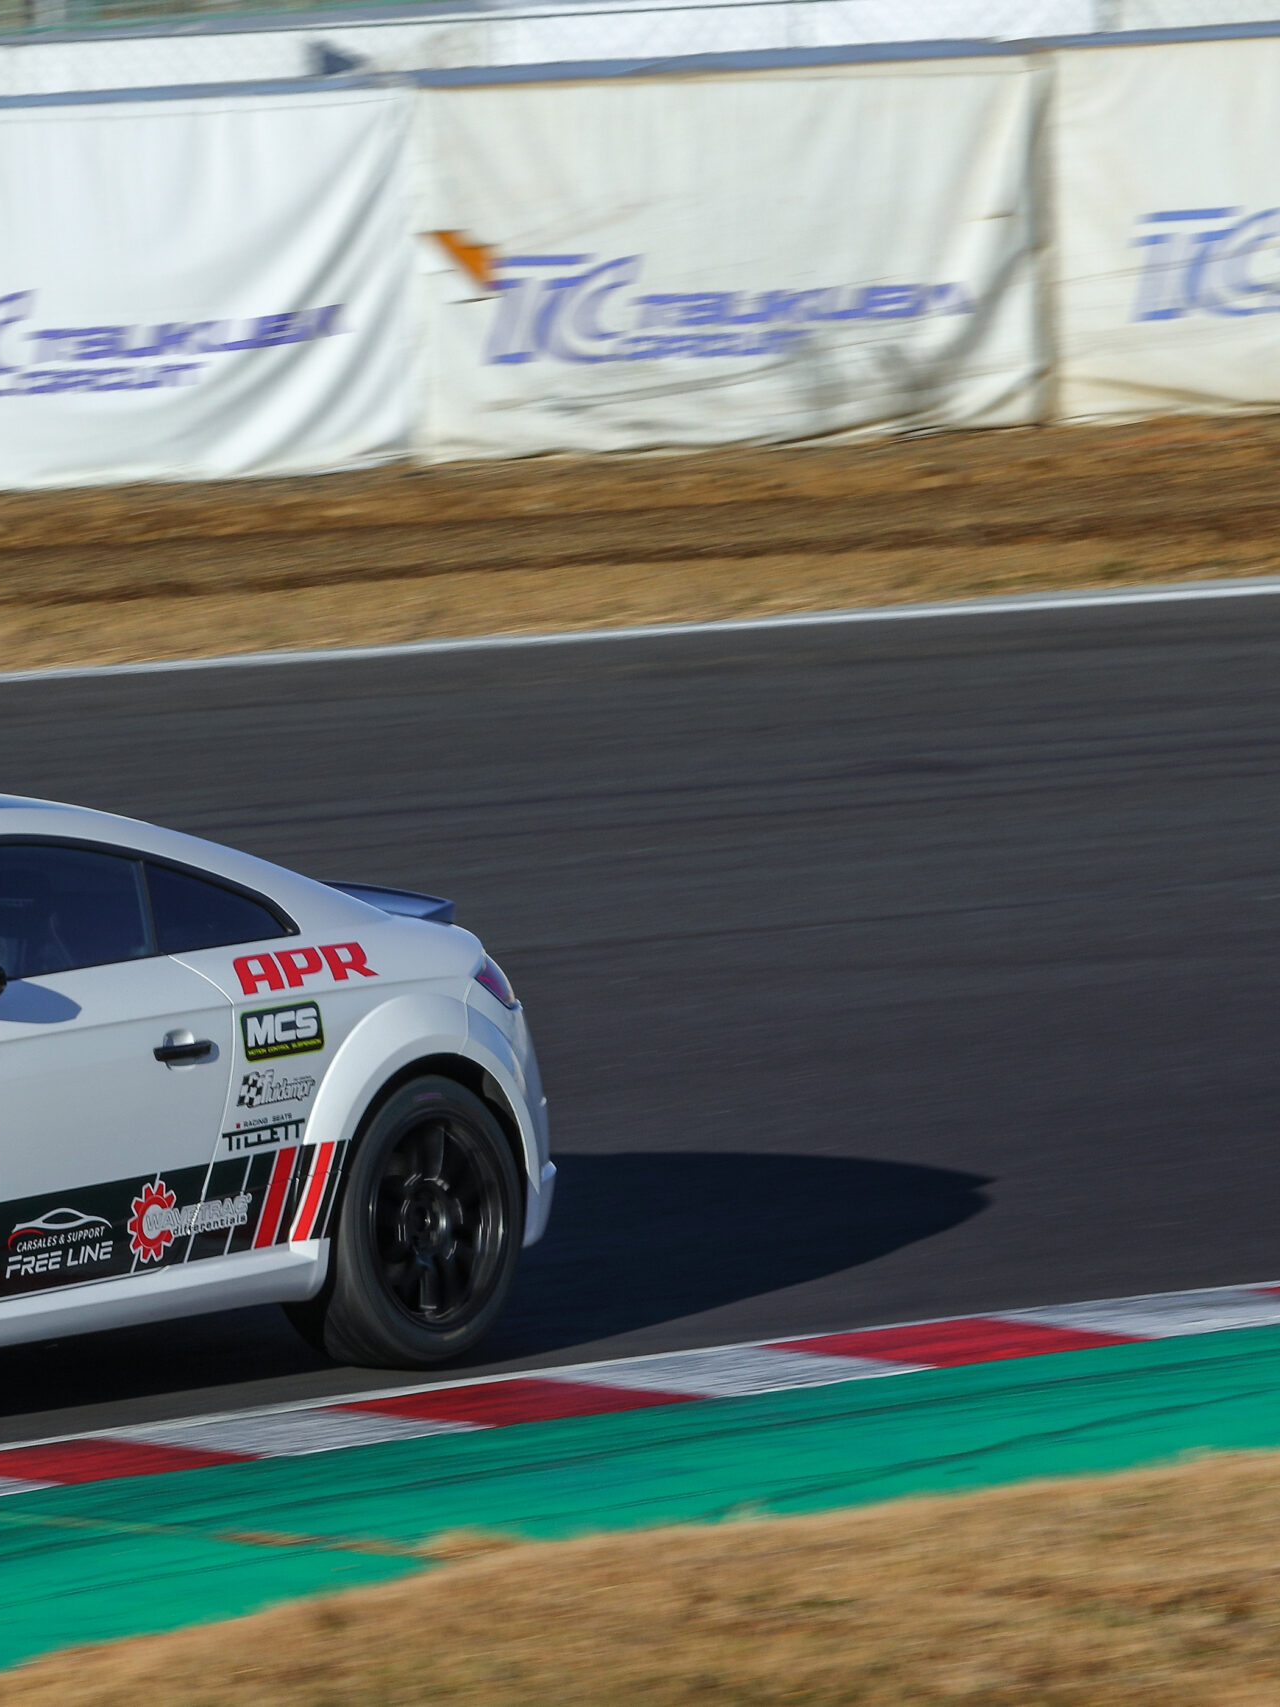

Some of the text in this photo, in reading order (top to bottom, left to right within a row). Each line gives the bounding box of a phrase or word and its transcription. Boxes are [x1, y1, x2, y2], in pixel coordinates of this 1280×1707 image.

[482, 254, 644, 365] TC
[233, 942, 379, 995] APR
[246, 1007, 318, 1048] MCS
[222, 1118, 305, 1152] TILLETT
[244, 1113, 292, 1127] RACING SEATS
[16, 1226, 105, 1253] CARSALES & SUPPORT
[173, 1214, 246, 1236] differentials
[5, 1240, 114, 1279] FREE LINE
